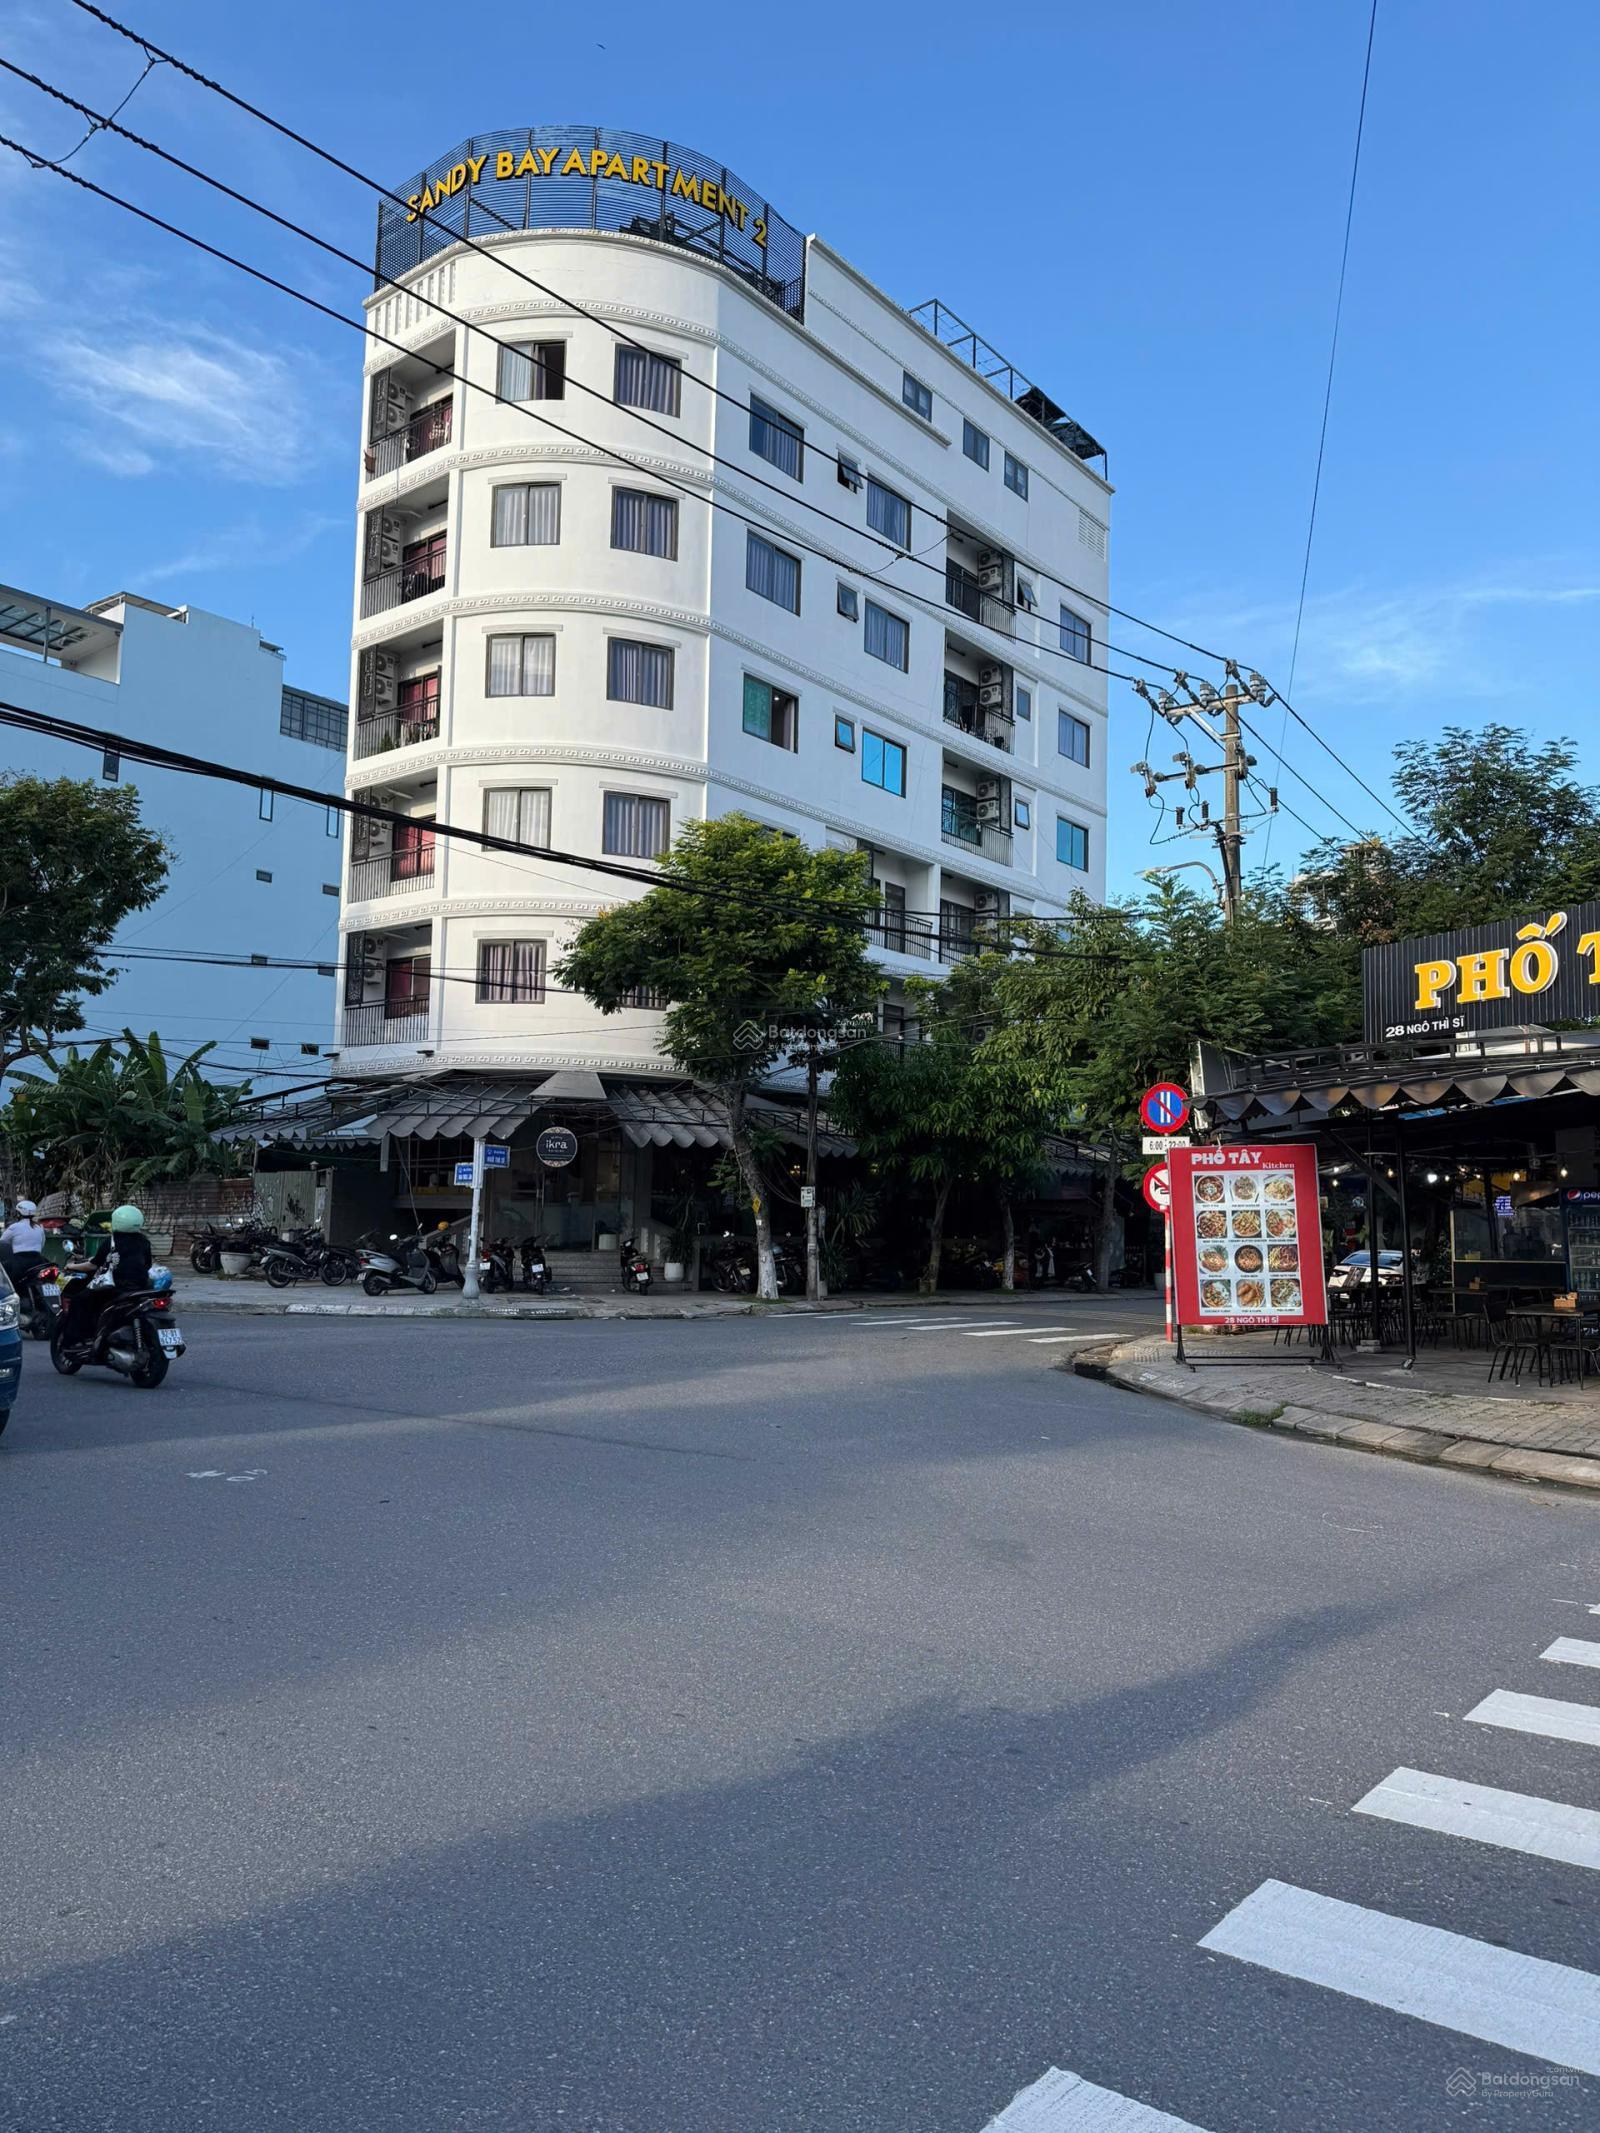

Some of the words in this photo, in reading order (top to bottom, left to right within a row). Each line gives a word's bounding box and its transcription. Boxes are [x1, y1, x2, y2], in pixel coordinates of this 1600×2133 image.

[406, 154, 489, 222] SANDY
[495, 147, 561, 180] BAY
[560, 147, 750, 231] APARTMENT
[753, 217, 769, 248] 2
[1413, 911, 1568, 1010] PHỐ
[1385, 1024, 1405, 1038] 28
[1406, 1020, 1430, 1035] NGÔ
[1431, 1016, 1450, 1031] THÌ
[1452, 1015, 1465, 1028] SĨ
[1228, 1148, 1262, 1165] TÂY
[1262, 1161, 1295, 1170] Kitchen
[1224, 1316, 1235, 1324] 28
